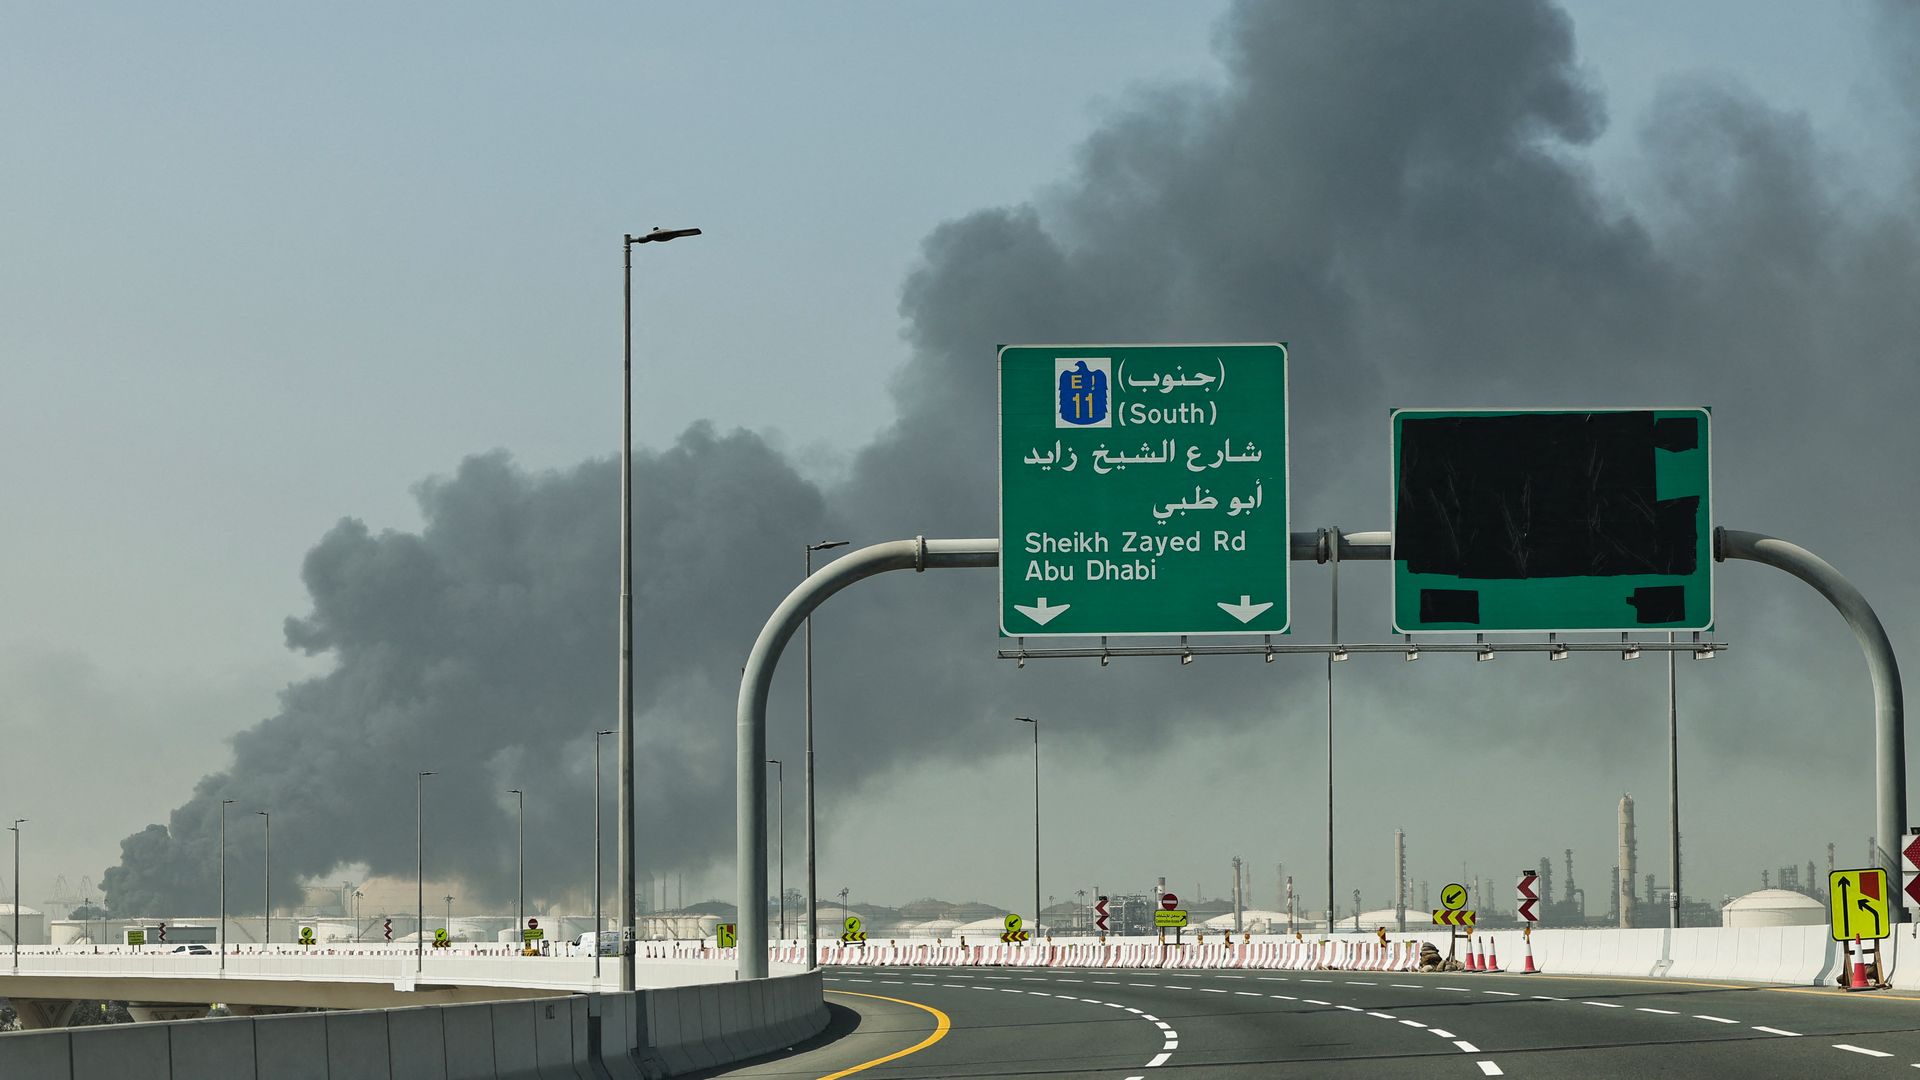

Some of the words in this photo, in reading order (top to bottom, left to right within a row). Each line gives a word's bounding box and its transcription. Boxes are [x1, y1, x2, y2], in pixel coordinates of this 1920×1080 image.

[1071, 375, 1083, 389] E
[1118, 356, 1226, 394] (جنوب)
[1072, 393, 1094, 418] 11
[1118, 400, 1217, 426] (South)
[1024, 439, 1078, 472] زايد
[1092, 438, 1176, 474] الشيخ
[1186, 438, 1263, 472] شارع
[1152, 484, 1219, 525] ظبي
[1226, 478, 1263, 516] أبو
[1025, 531, 1109, 553] Sheikh
[1122, 531, 1201, 556] Zayed
[1214, 530, 1247, 552] Rd
[1025, 560, 1074, 581] Abu
[1086, 558, 1156, 581] Dhabi
